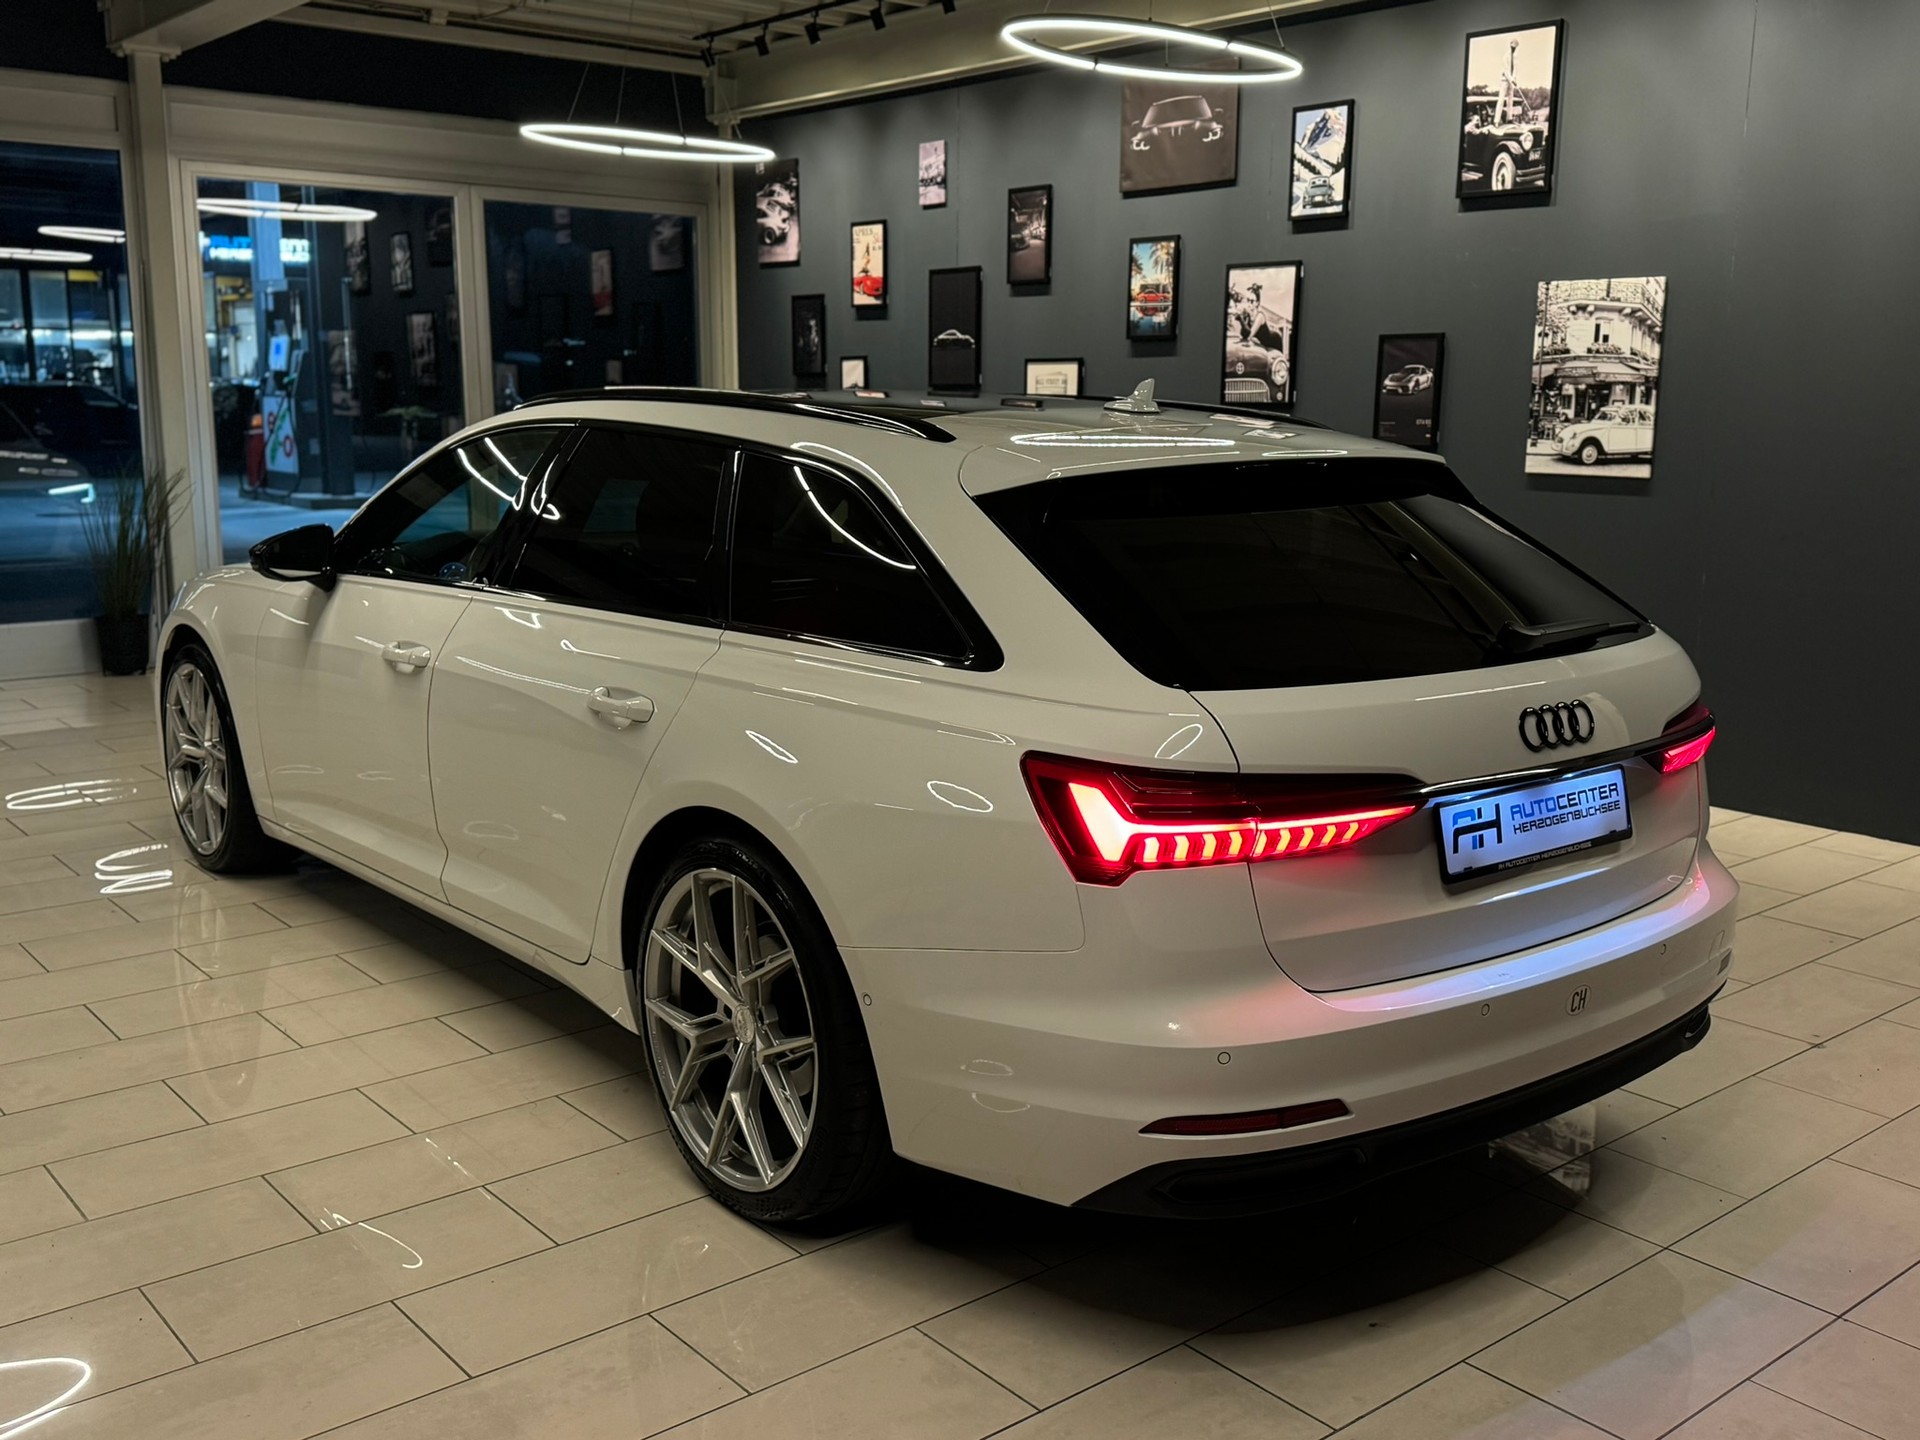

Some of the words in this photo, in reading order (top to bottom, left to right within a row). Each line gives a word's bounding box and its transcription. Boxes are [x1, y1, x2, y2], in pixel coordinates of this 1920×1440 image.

[1510, 782, 1620, 821] AUTOCENTER
[1513, 799, 1621, 835] HERZOGENBUCHSEE
[1570, 987, 1588, 1013] CH
